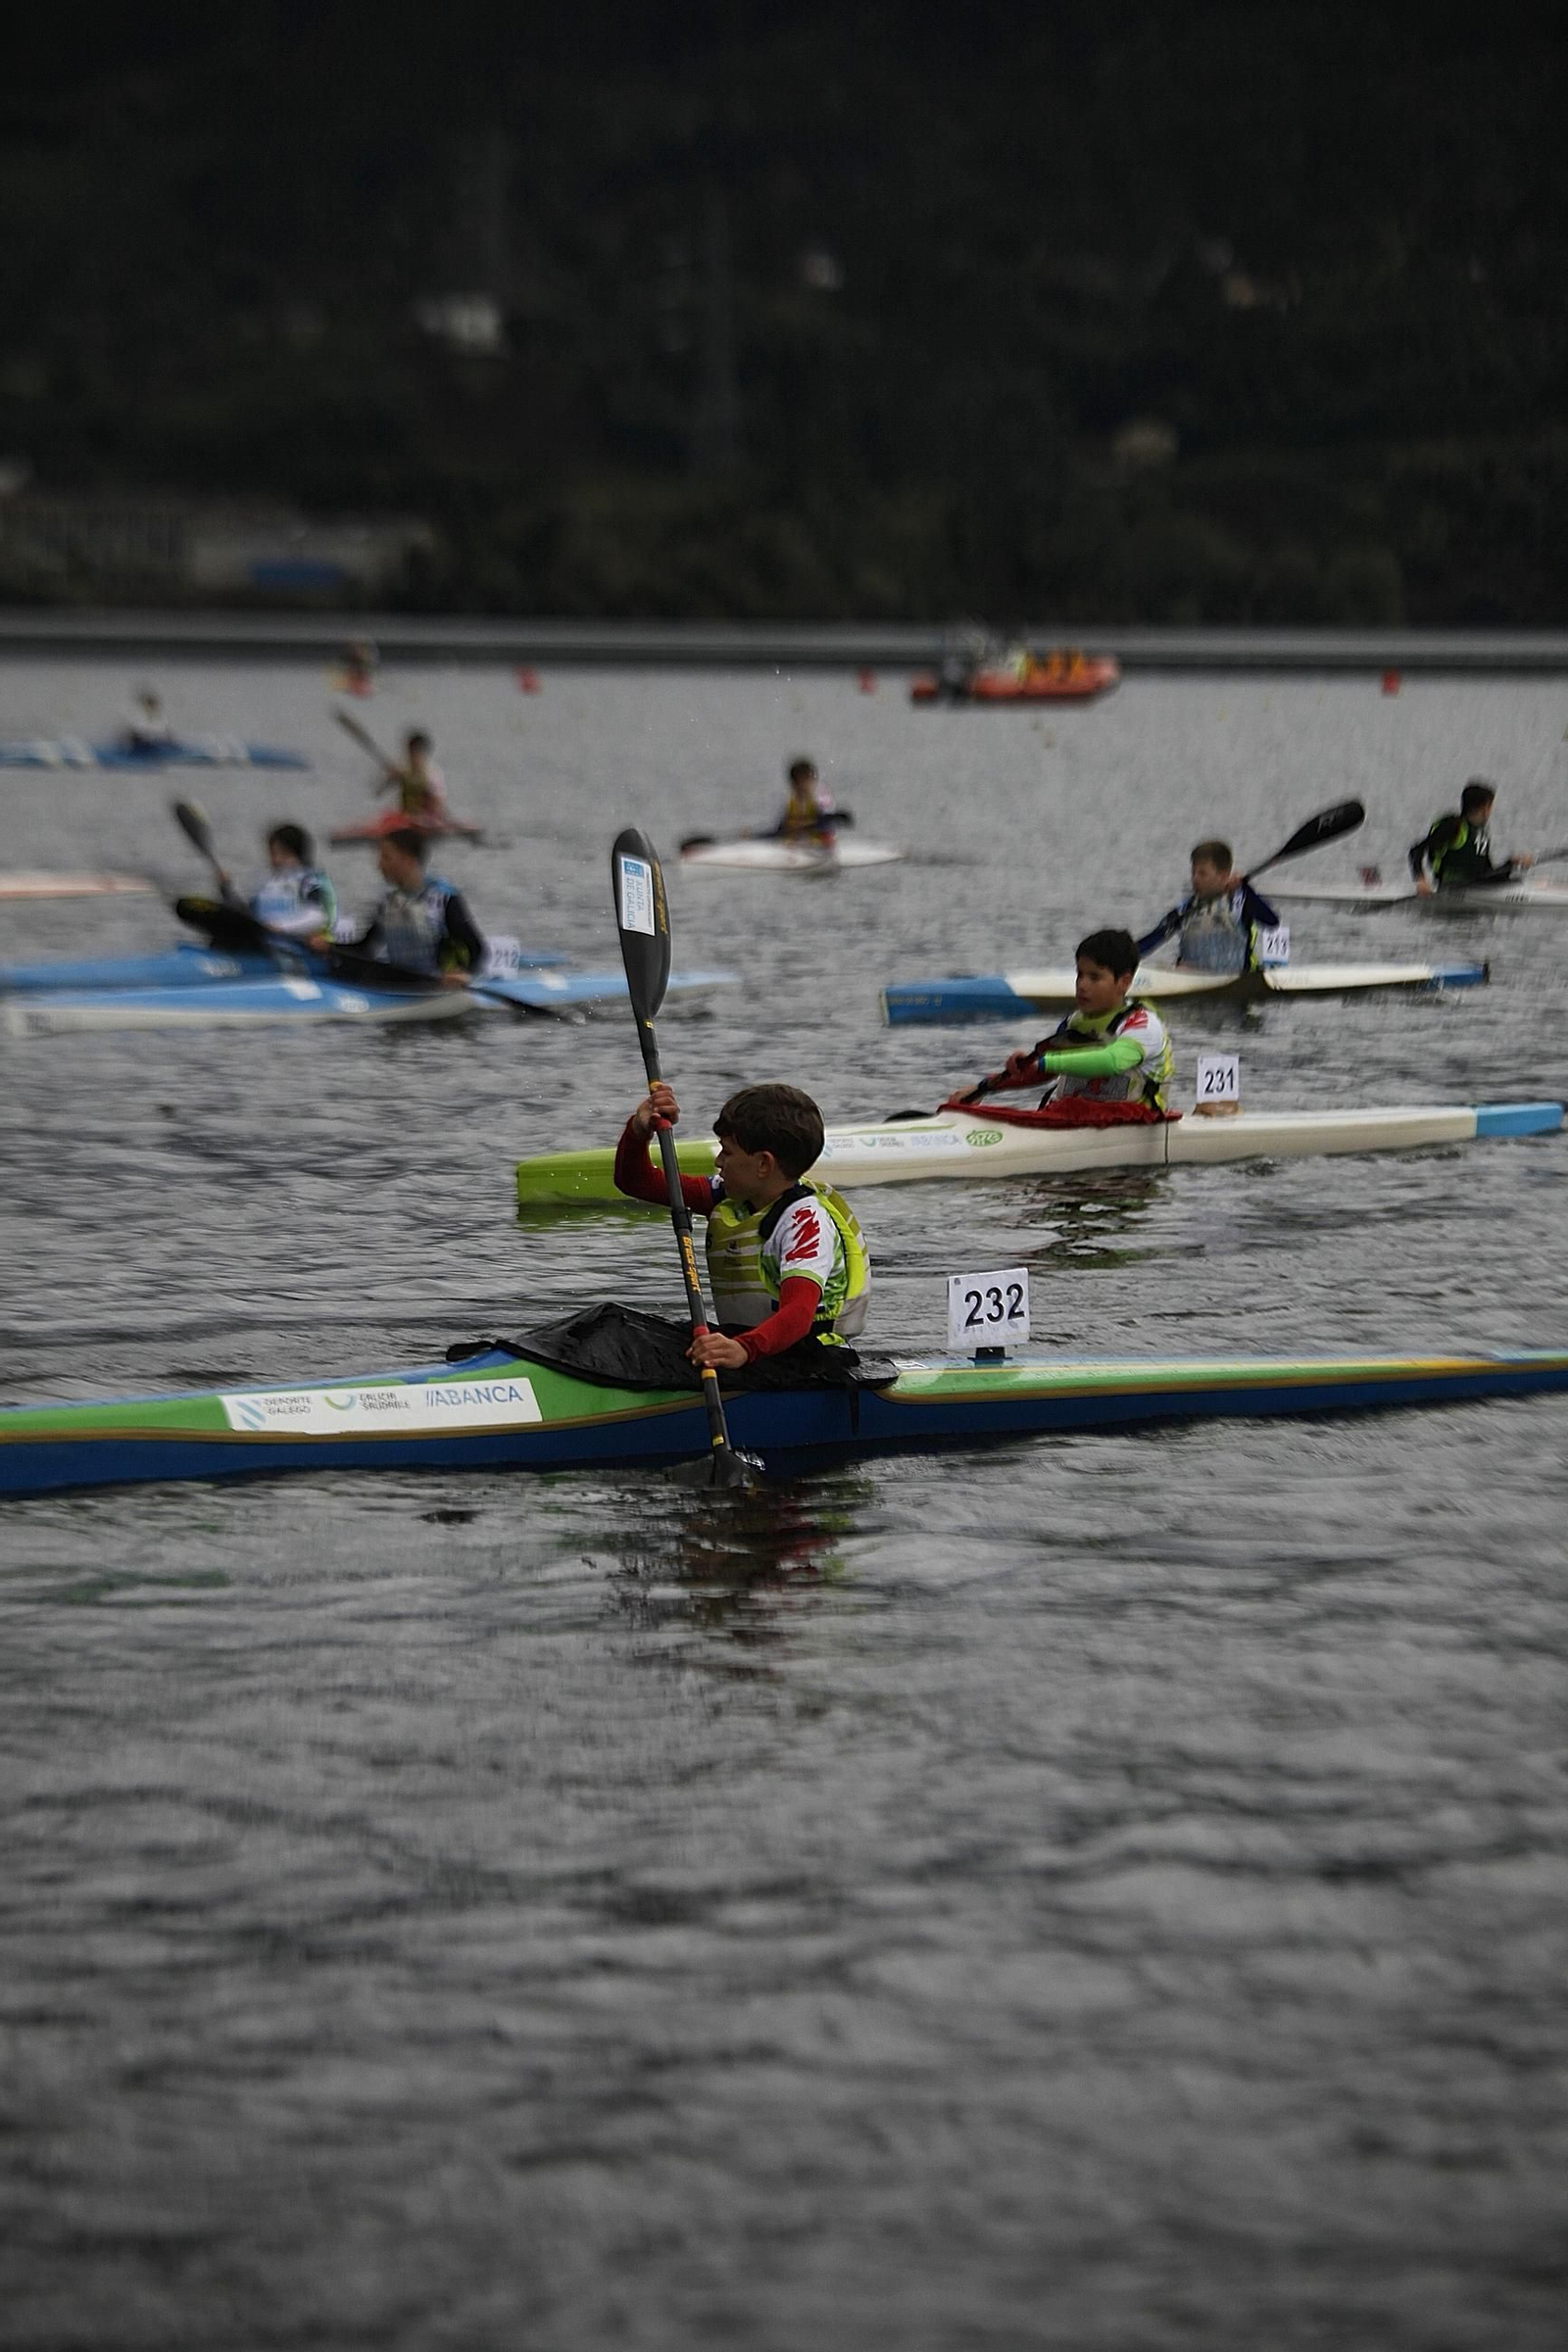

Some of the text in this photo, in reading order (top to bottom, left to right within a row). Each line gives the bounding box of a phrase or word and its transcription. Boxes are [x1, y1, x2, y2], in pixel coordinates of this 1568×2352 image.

[626, 878, 635, 929] DE GALICIA
[635, 881, 645, 911] XUNTA
[1204, 1066, 1234, 1094] 231
[964, 1283, 1025, 1328] 232
